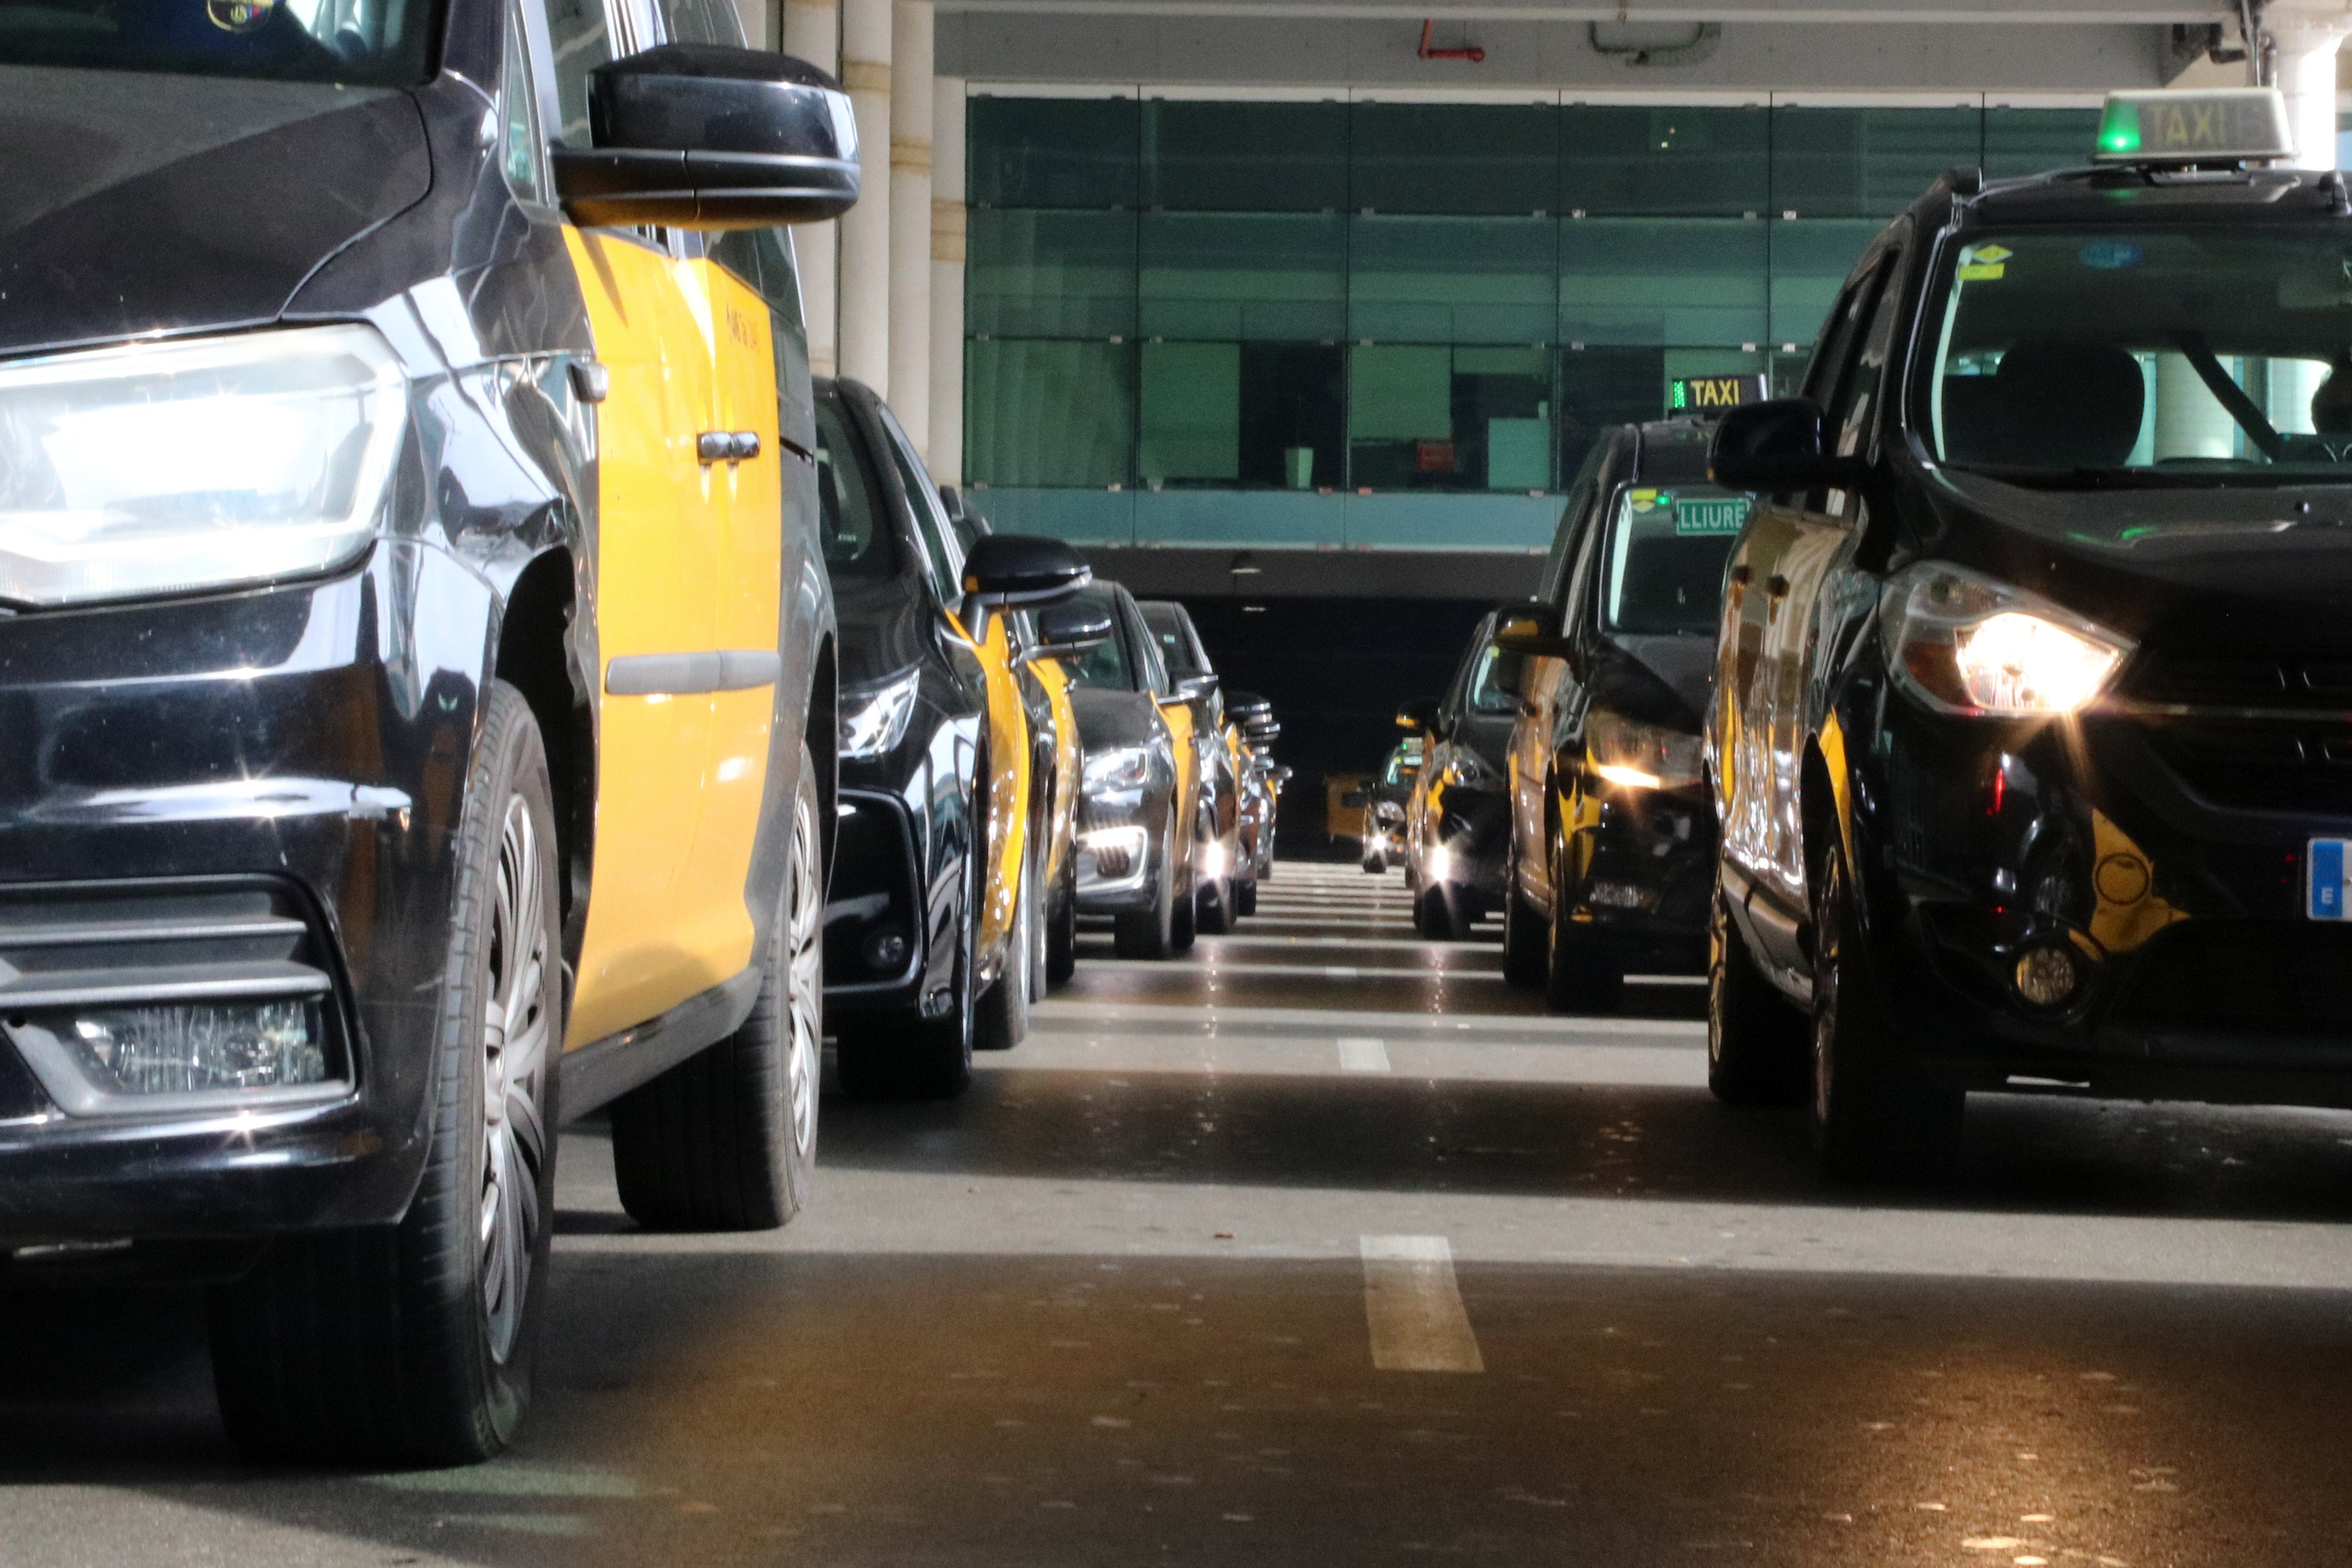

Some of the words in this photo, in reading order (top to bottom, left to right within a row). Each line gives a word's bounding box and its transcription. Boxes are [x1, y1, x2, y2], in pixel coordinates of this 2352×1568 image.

[2150, 102, 2226, 144] TAXI
[1690, 379, 1740, 406] TAXI
[1681, 504, 1746, 529] LLIURE
[2321, 886, 2334, 905] E
